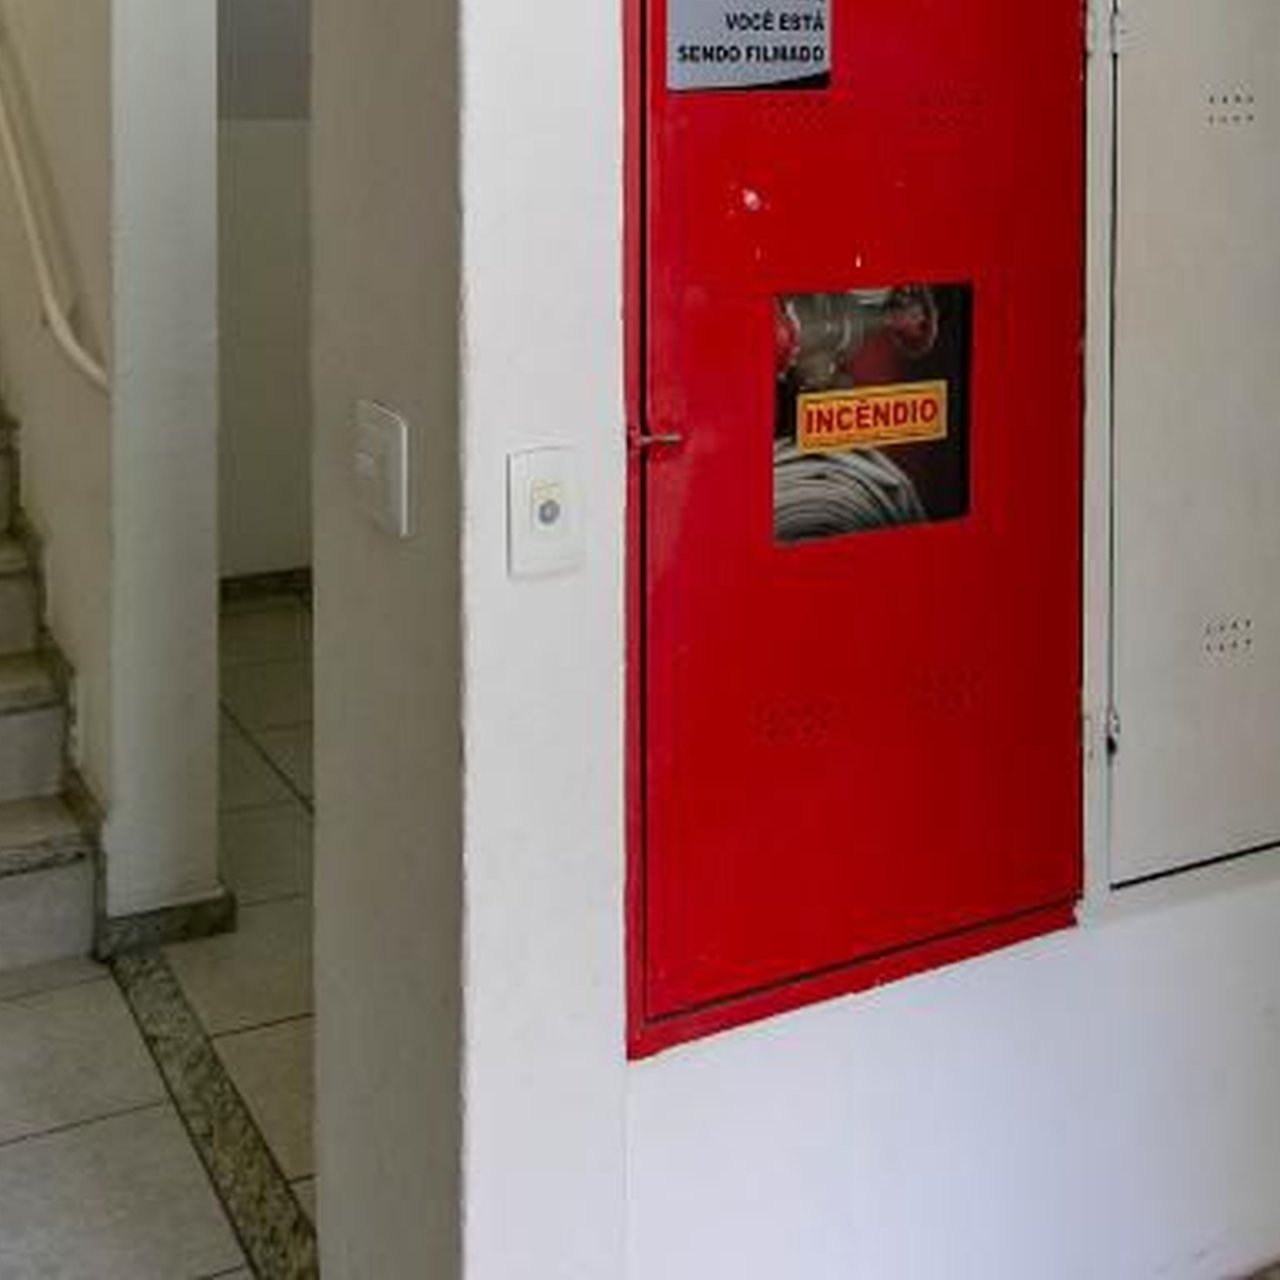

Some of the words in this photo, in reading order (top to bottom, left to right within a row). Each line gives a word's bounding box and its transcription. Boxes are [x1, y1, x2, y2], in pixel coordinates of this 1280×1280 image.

[725, 9, 775, 31] VOCÊ
[780, 9, 825, 32] ESTÁ
[677, 45, 742, 62] SENDO
[745, 45, 825, 62] FILMADO
[805, 397, 939, 435] INCÊNDIO
